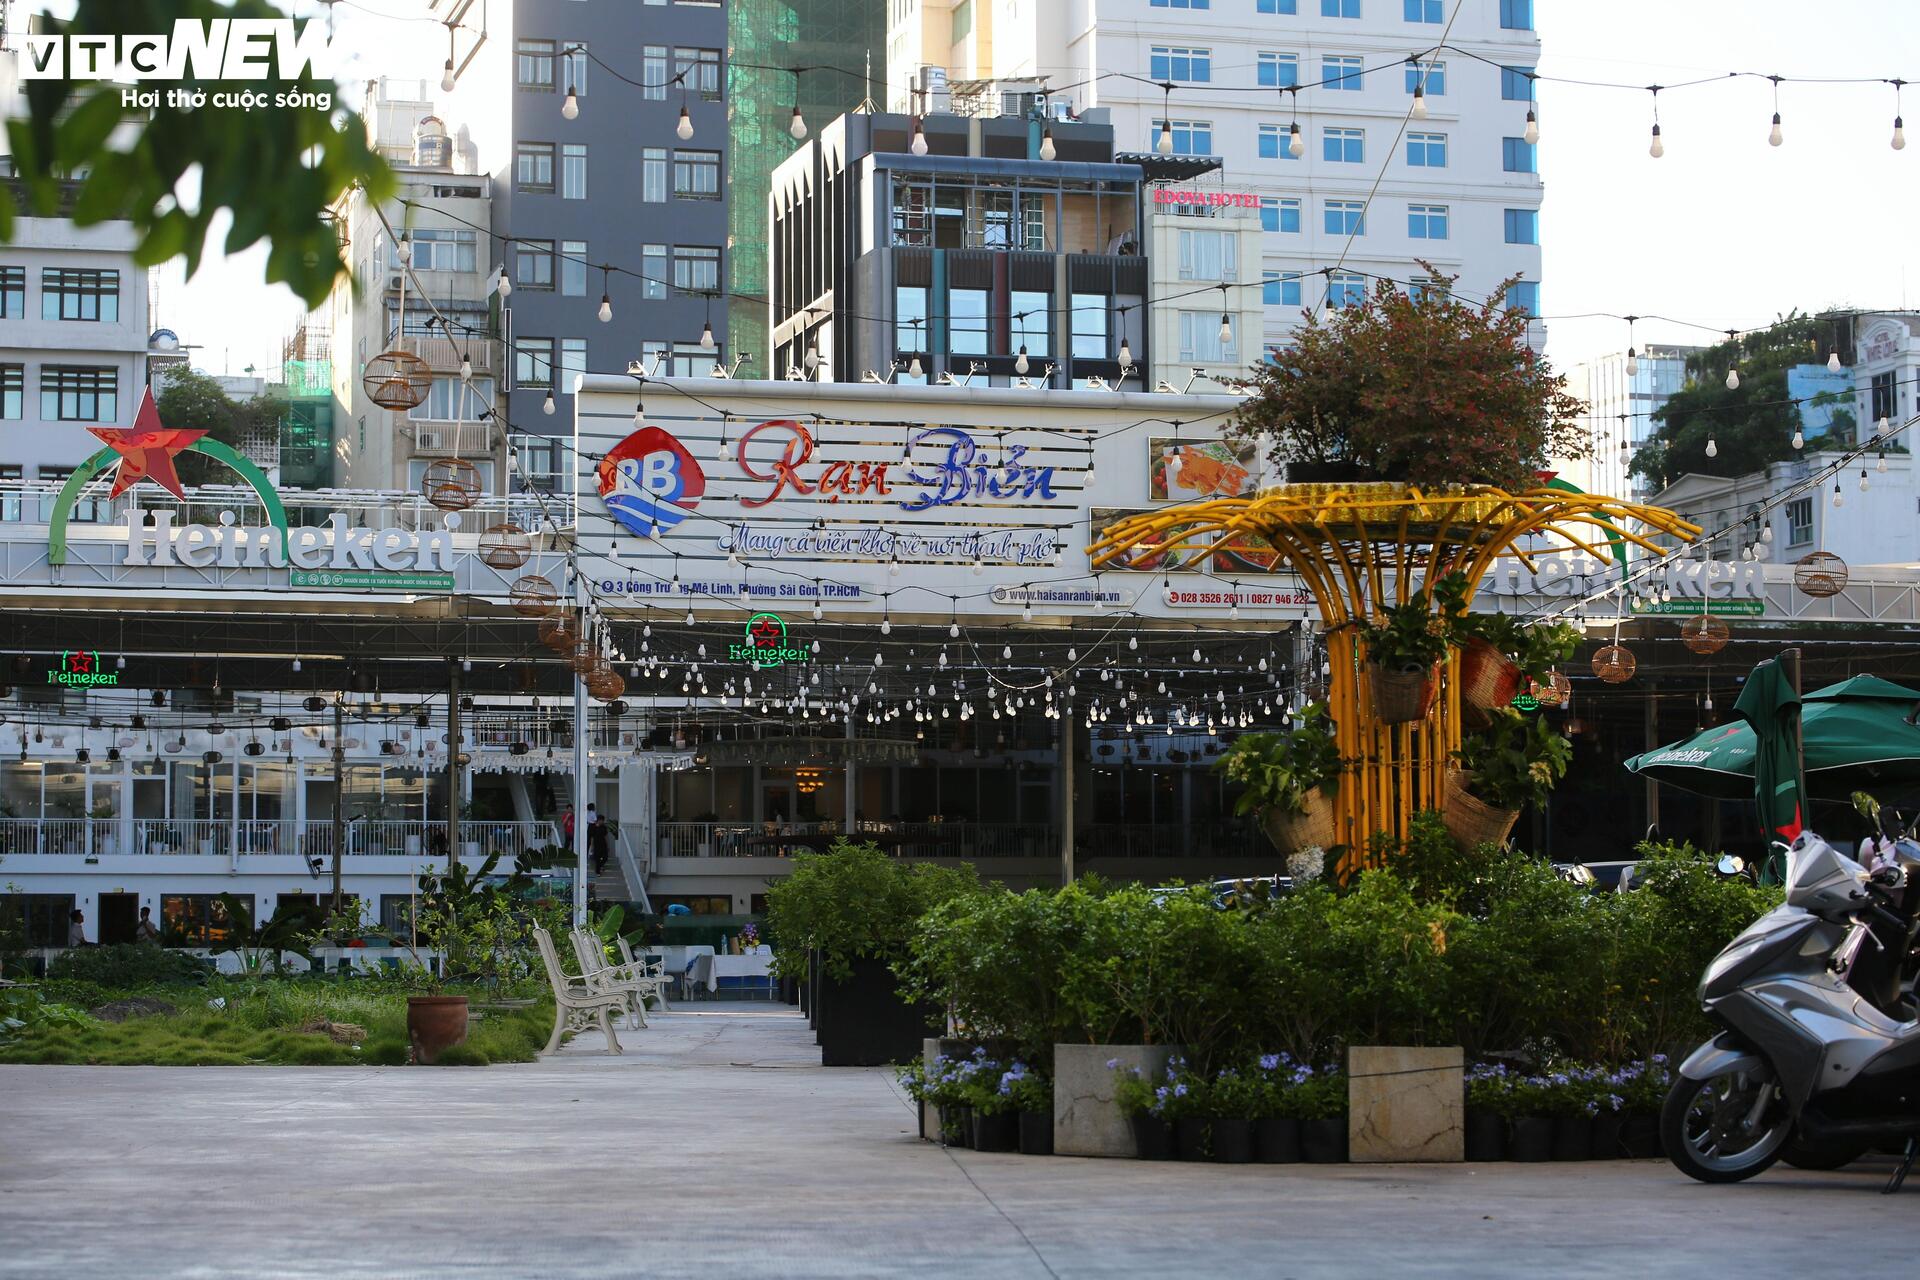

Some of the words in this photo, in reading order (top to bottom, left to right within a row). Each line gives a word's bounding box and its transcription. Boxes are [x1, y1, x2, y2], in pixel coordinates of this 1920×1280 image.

[1153, 189, 1206, 205] EDOYA
[1208, 192, 1263, 208] HOTEL
[615, 449, 677, 497] RB
[738, 420, 892, 507] Rạn
[899, 428, 1058, 511] Biển
[122, 509, 462, 570] Heineken
[718, 522, 784, 558] Mang
[787, 532, 810, 553] cả
[1018, 532, 1057, 563] phố
[616, 581, 623, 592] 3
[655, 582, 689, 595] Trưng
[711, 582, 736, 595] Linh,
[824, 585, 860, 597] TP.HCM
[1181, 593, 1197, 603] 028
[1200, 593, 1221, 604] 3526
[1223, 593, 1243, 604] 2611
[1251, 594, 1272, 604] 0827
[1275, 594, 1292, 604] 946
[728, 644, 809, 661] Heineken
[47, 670, 118, 685] Heineken
